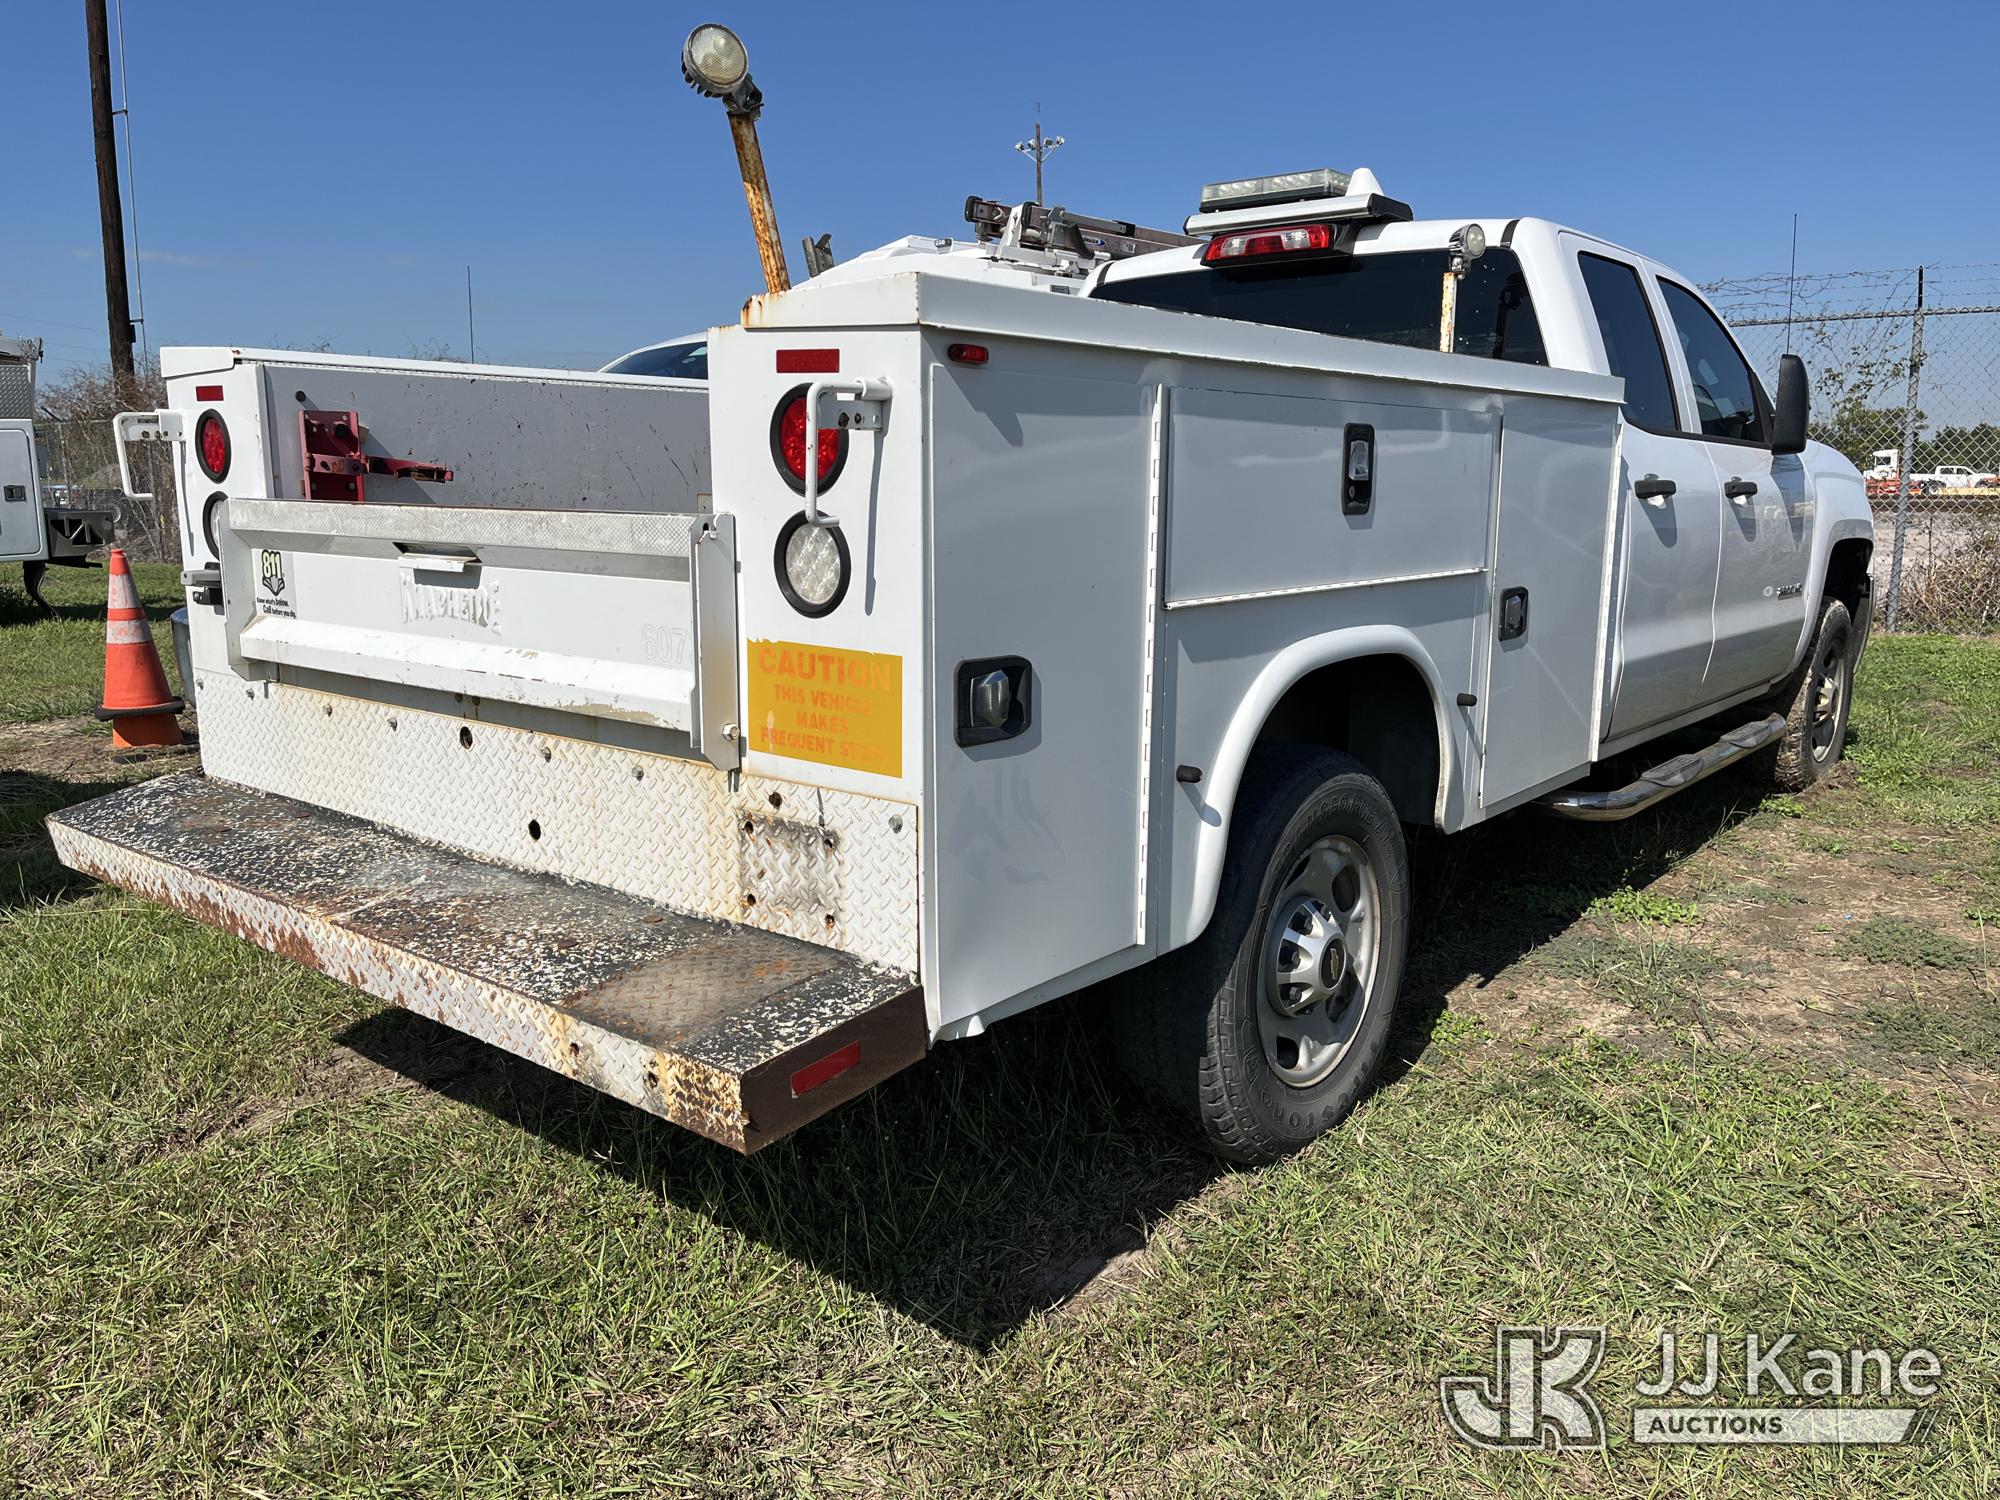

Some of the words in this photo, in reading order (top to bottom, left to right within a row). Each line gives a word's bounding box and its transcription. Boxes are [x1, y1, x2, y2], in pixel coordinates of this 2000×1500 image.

[262, 549, 282, 579] 811
[758, 647, 892, 690] CAUTION
[773, 684, 806, 705] THIS
[796, 710, 849, 736] MAKES
[760, 726, 836, 754] FREQUENT
